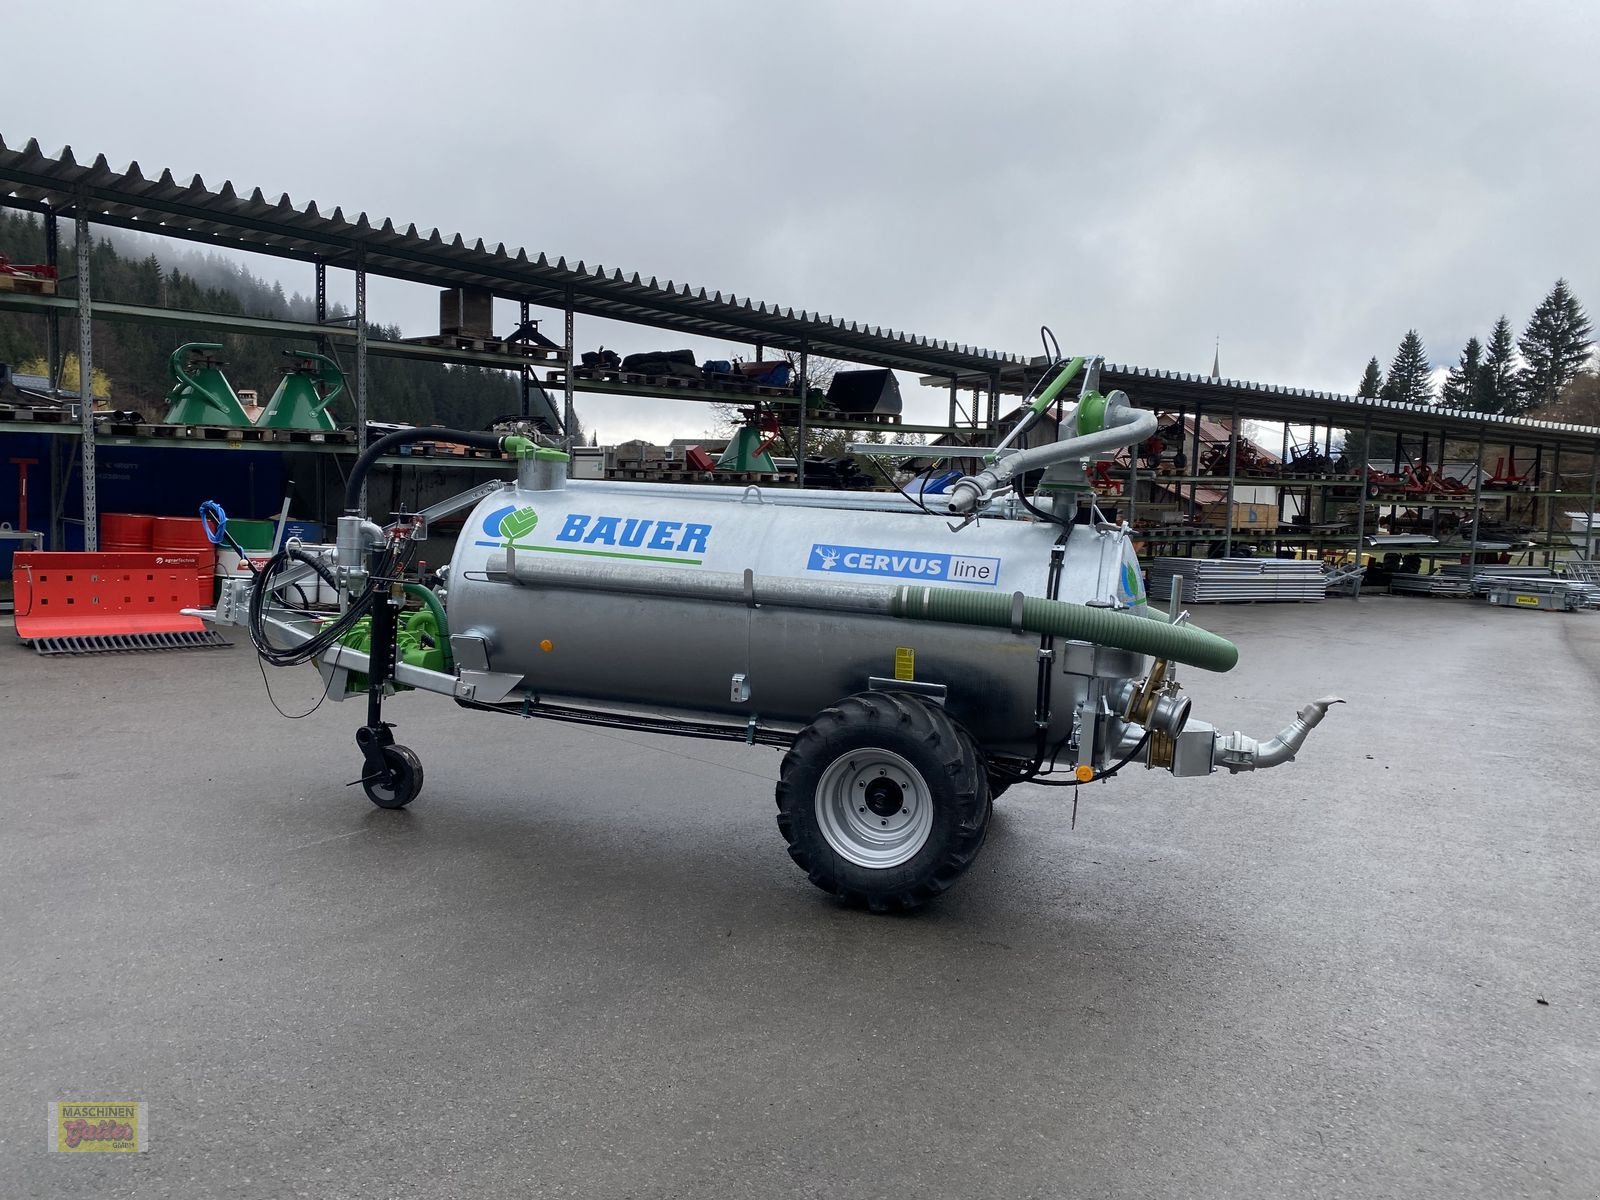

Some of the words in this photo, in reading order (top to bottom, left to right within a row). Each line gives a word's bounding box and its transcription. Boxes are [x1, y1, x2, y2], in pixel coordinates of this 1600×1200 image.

[555, 513, 713, 554] BAUER
[843, 553, 942, 575] CERVUS
[953, 560, 990, 579] line
